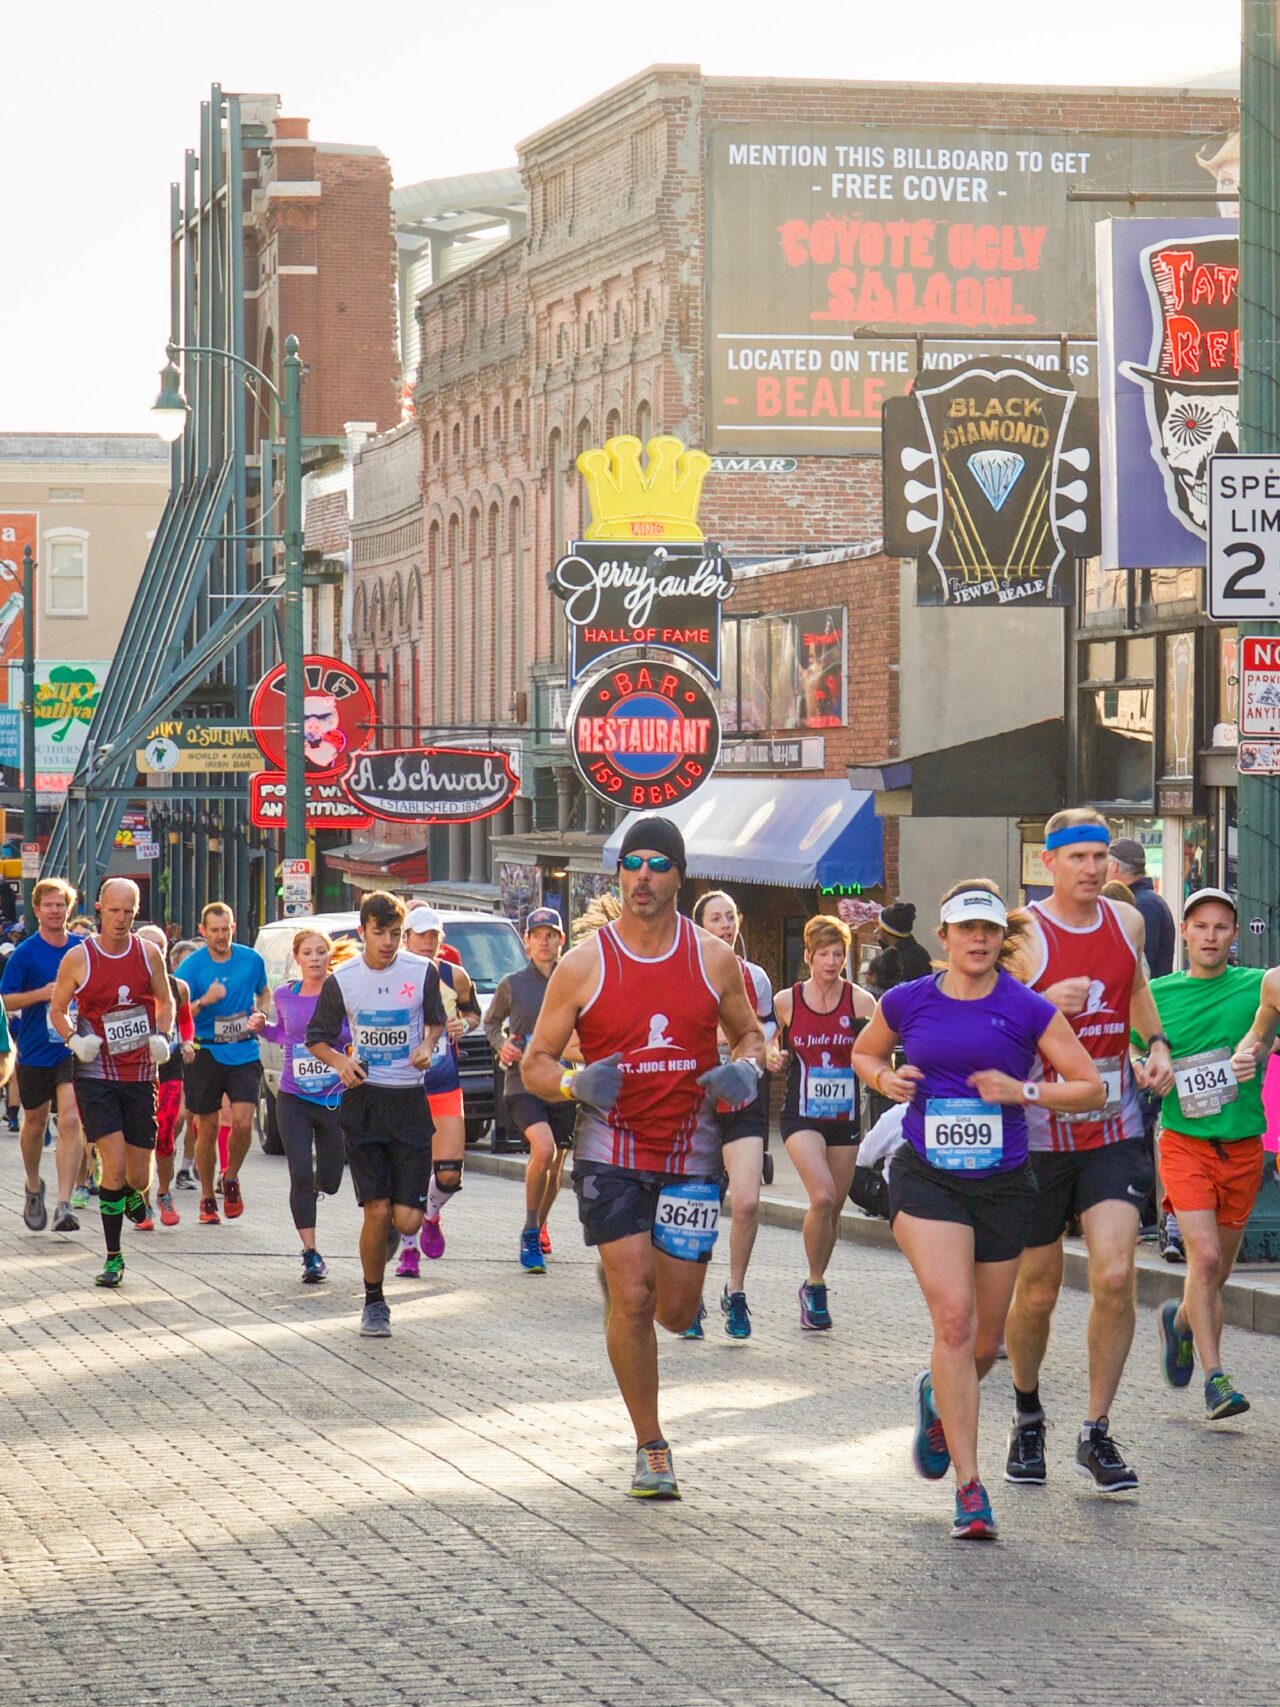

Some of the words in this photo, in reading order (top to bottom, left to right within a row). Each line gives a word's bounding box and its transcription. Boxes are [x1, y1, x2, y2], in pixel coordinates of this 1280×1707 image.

[729, 143, 828, 167] MENTION
[836, 145, 886, 169] THIS
[893, 147, 1009, 173] BILLBOARD
[1016, 150, 1044, 173] TO
[1050, 151, 1091, 174] GET
[831, 176, 894, 200] FREE
[903, 176, 988, 203] COVER
[777, 211, 936, 270] COYOTE
[948, 222, 1047, 271] UGLY
[728, 348, 822, 371] LOCATED
[830, 349, 859, 372] ON
[867, 351, 909, 374] THE
[756, 378, 882, 417] BEALE
[949, 397, 1042, 418] BLACK
[943, 420, 1050, 450] DIAMOND
[709, 459, 787, 471] AMAR
[556, 555, 650, 626] Jerry
[627, 547, 736, 628] Lawler
[948, 576, 967, 588] The
[953, 580, 999, 604] JEWEL
[998, 579, 1046, 604] BEALE
[1001, 576, 1012, 588] of
[584, 629, 630, 642] HALL
[633, 629, 656, 642] OF
[662, 629, 710, 643] FAME
[36, 682, 96, 702] SILKY
[614, 667, 679, 698] BAR
[187, 725, 254, 747] O'SULLIVA
[577, 716, 711, 753] RESTAURANT
[188, 752, 219, 761] WORLD
[205, 761, 229, 769] IRISH
[232, 761, 251, 769] BAR
[350, 757, 384, 791] A.
[387, 755, 508, 791] Schwab
[590, 761, 624, 794] 159
[631, 760, 705, 804] BEALE
[260, 802, 283, 817] AN
[380, 800, 460, 814] ESTABLISHED
[462, 800, 484, 812] 1876
[107, 1019, 147, 1042] 30546
[222, 1023, 242, 1035] 280
[360, 1030, 408, 1047] 36069
[1102, 1022, 1125, 1035] HERO
[793, 1035, 805, 1047] St.
[807, 1033, 831, 1048] Jude
[832, 1033, 855, 1046] Her
[617, 1063, 634, 1075] ST.
[636, 1061, 666, 1073] JUDE
[667, 1059, 698, 1072] HERO
[814, 1083, 846, 1098] 9071
[1184, 1068, 1229, 1094] 1934
[935, 1123, 992, 1145] 6699
[660, 1203, 719, 1230] 36417
